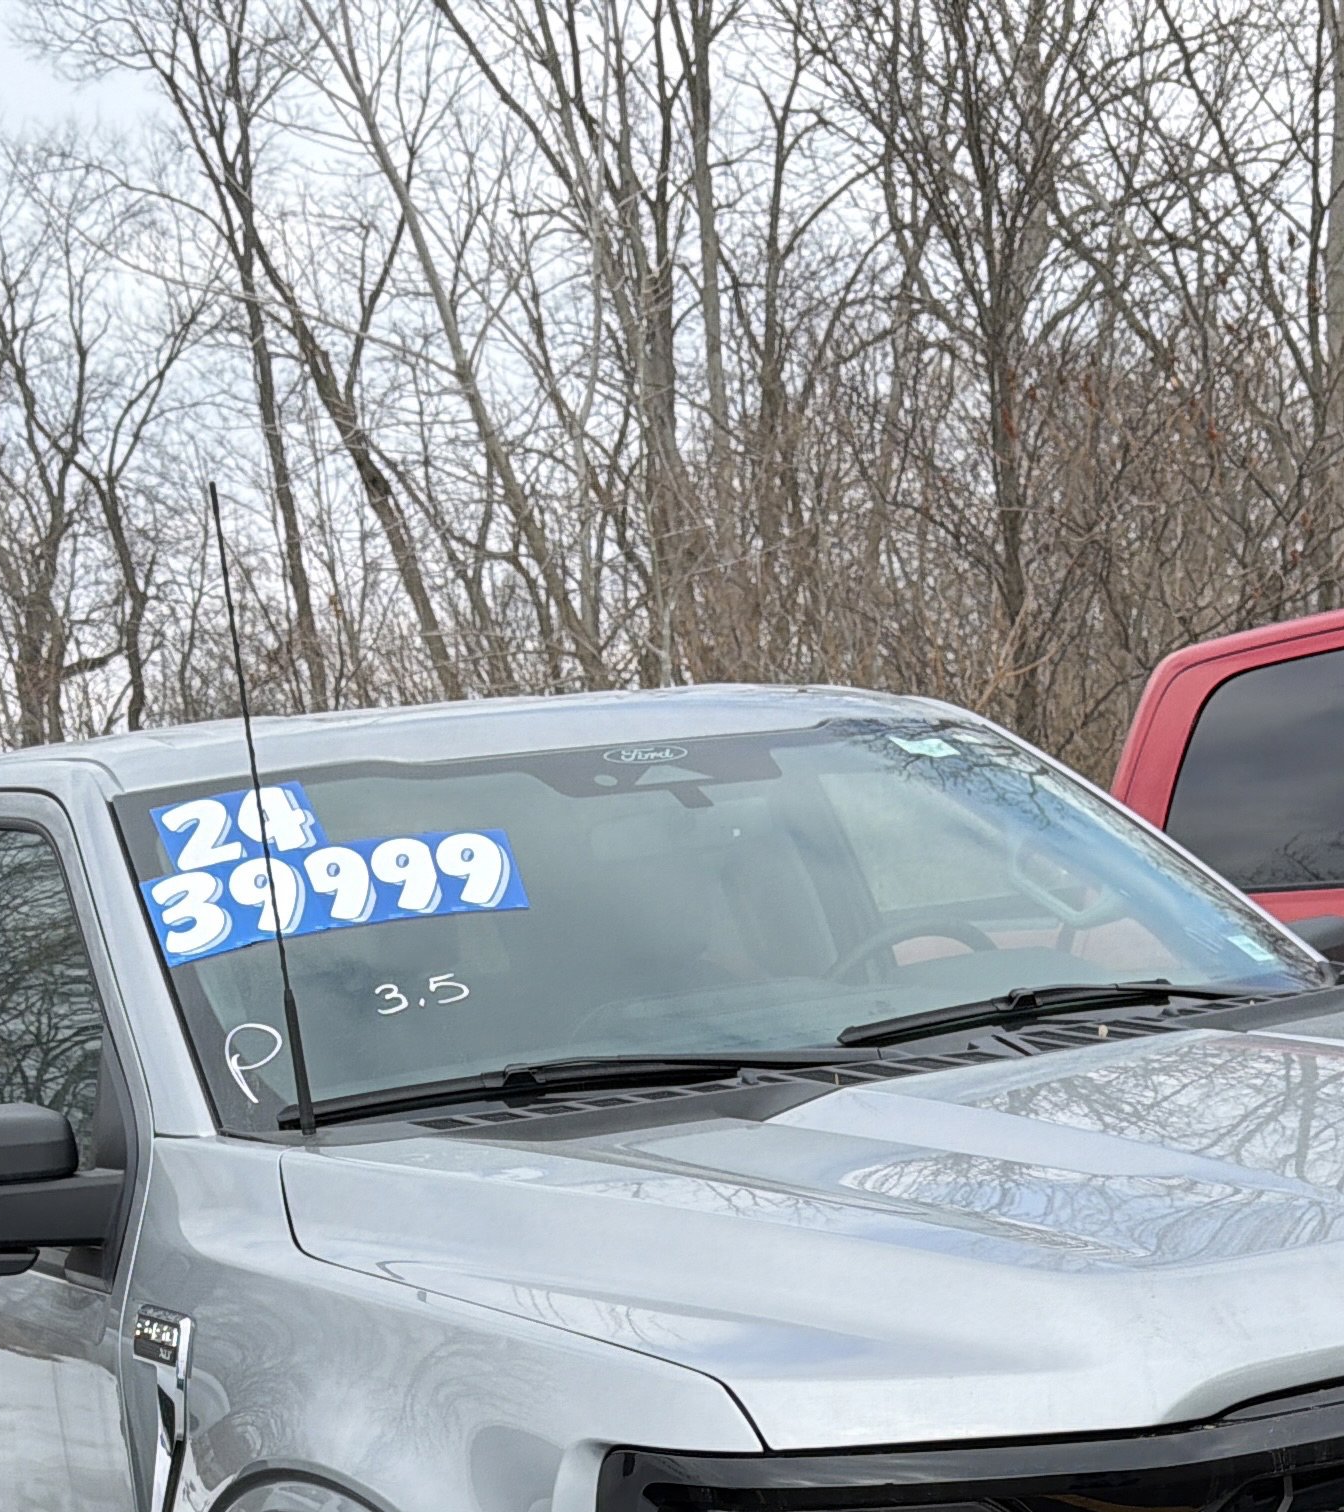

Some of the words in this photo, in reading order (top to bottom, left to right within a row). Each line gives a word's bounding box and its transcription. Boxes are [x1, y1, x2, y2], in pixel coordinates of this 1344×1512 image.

[620, 747, 674, 763] Ford
[161, 786, 316, 871] 24
[151, 833, 511, 955] 39999
[374, 972, 470, 1015] 3.5
